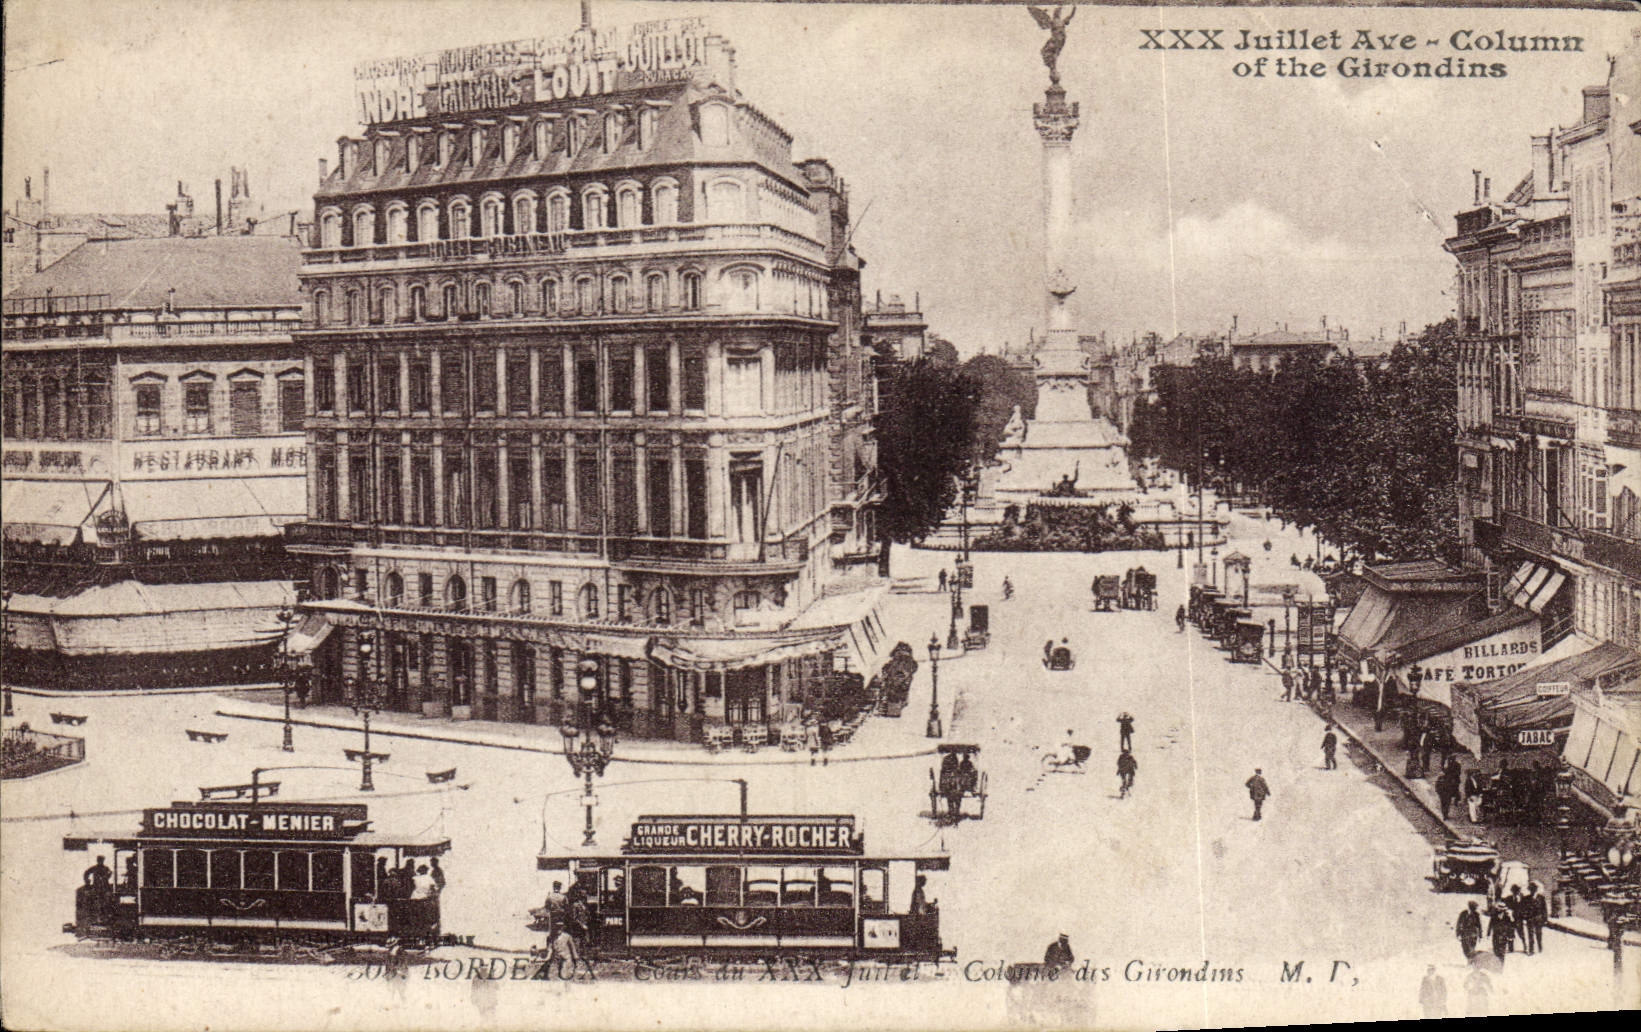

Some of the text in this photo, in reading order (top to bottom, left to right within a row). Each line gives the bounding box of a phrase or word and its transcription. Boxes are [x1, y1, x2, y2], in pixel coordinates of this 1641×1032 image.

[534, 60, 617, 102] LOUIT
[1463, 641, 1538, 659] BILLARDS
[1521, 732, 1552, 744] TABAC
[637, 825, 679, 836] GRANDE
[686, 827, 850, 849] CHERRY-ROCHER
[633, 837, 686, 848] LIQUEUR
